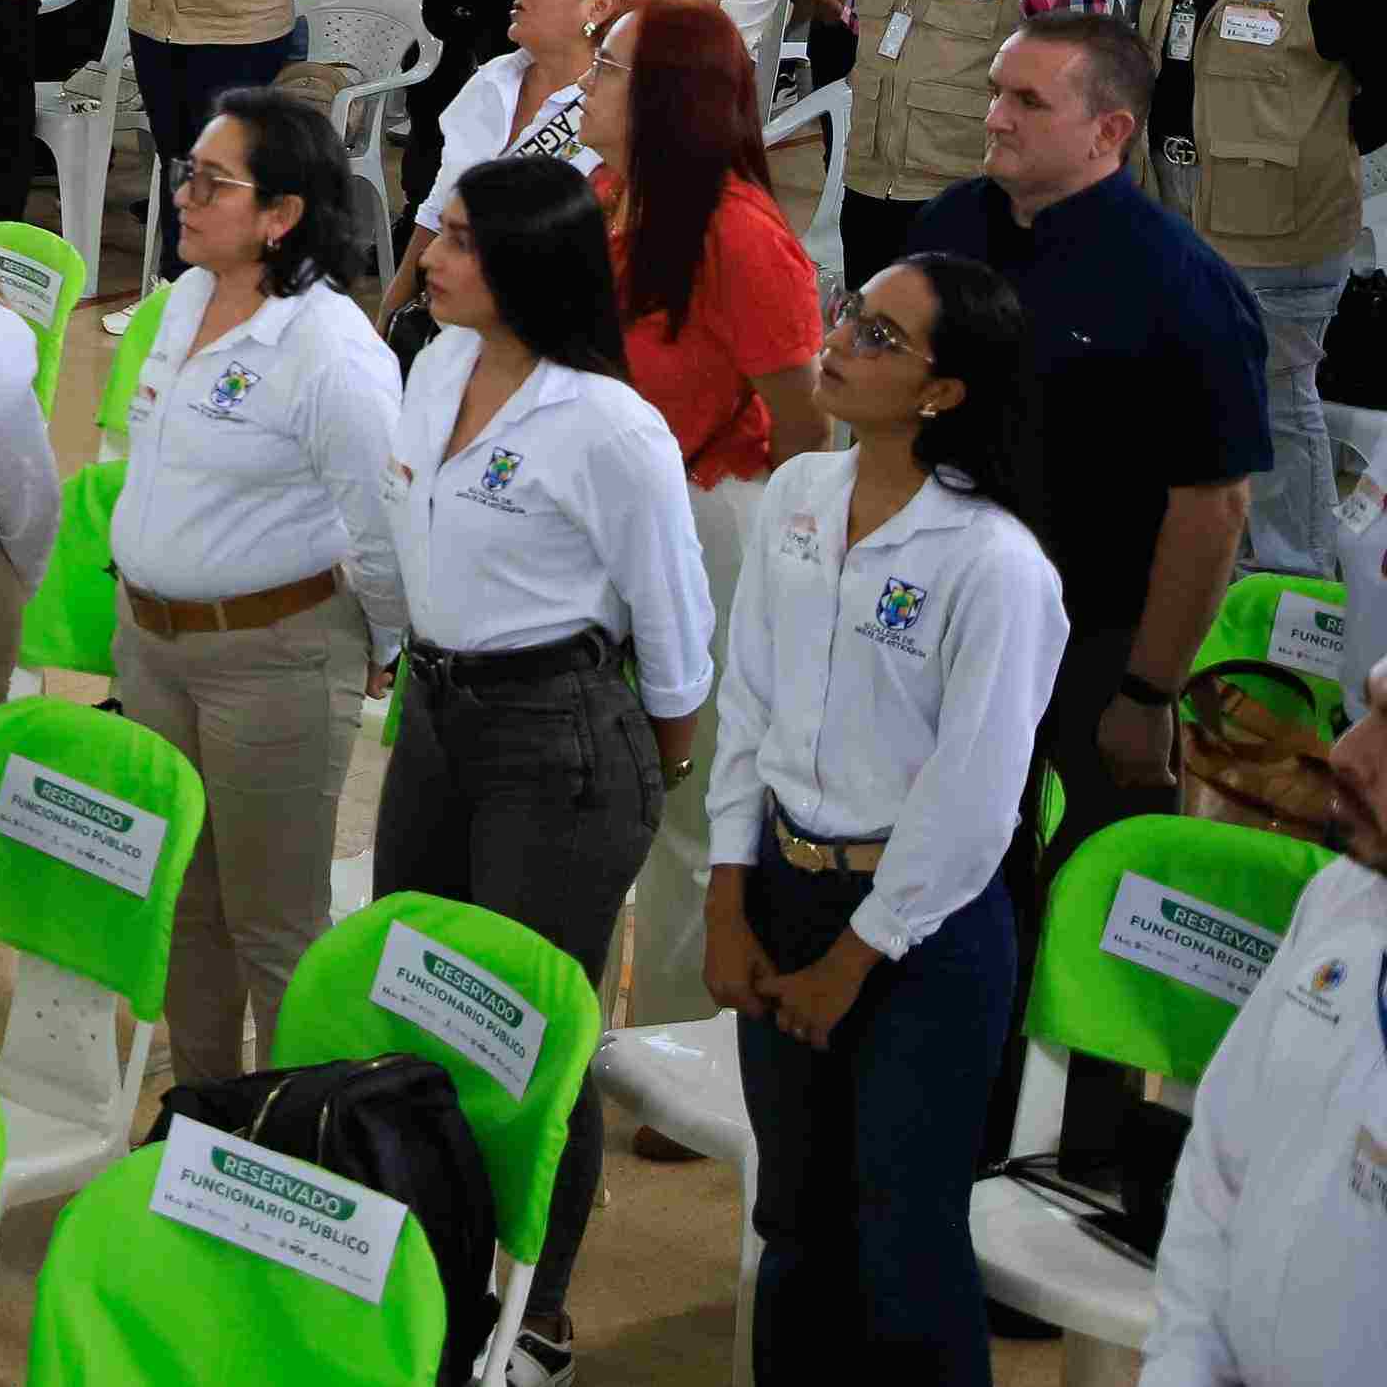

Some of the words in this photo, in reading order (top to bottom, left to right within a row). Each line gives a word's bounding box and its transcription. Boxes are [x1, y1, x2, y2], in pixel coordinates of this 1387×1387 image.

[1291, 629, 1344, 652] FUNCIO
[11, 794, 91, 839] FUNCIONARIO
[92, 829, 142, 860] PÚBLICO
[42, 782, 126, 831] RESERVADO
[1130, 914, 1244, 972] FUNCIONARIO
[1173, 907, 1275, 962] RESERVAD
[396, 967, 485, 1029] FUNCIONARIO
[487, 1019, 526, 1060] PÚBLICO
[432, 958, 517, 1023] RESERVADO
[180, 1167, 296, 1225] FUNCIONARIO
[298, 1214, 371, 1256] PÚBLICO
[221, 1154, 341, 1217] RESERVADO
